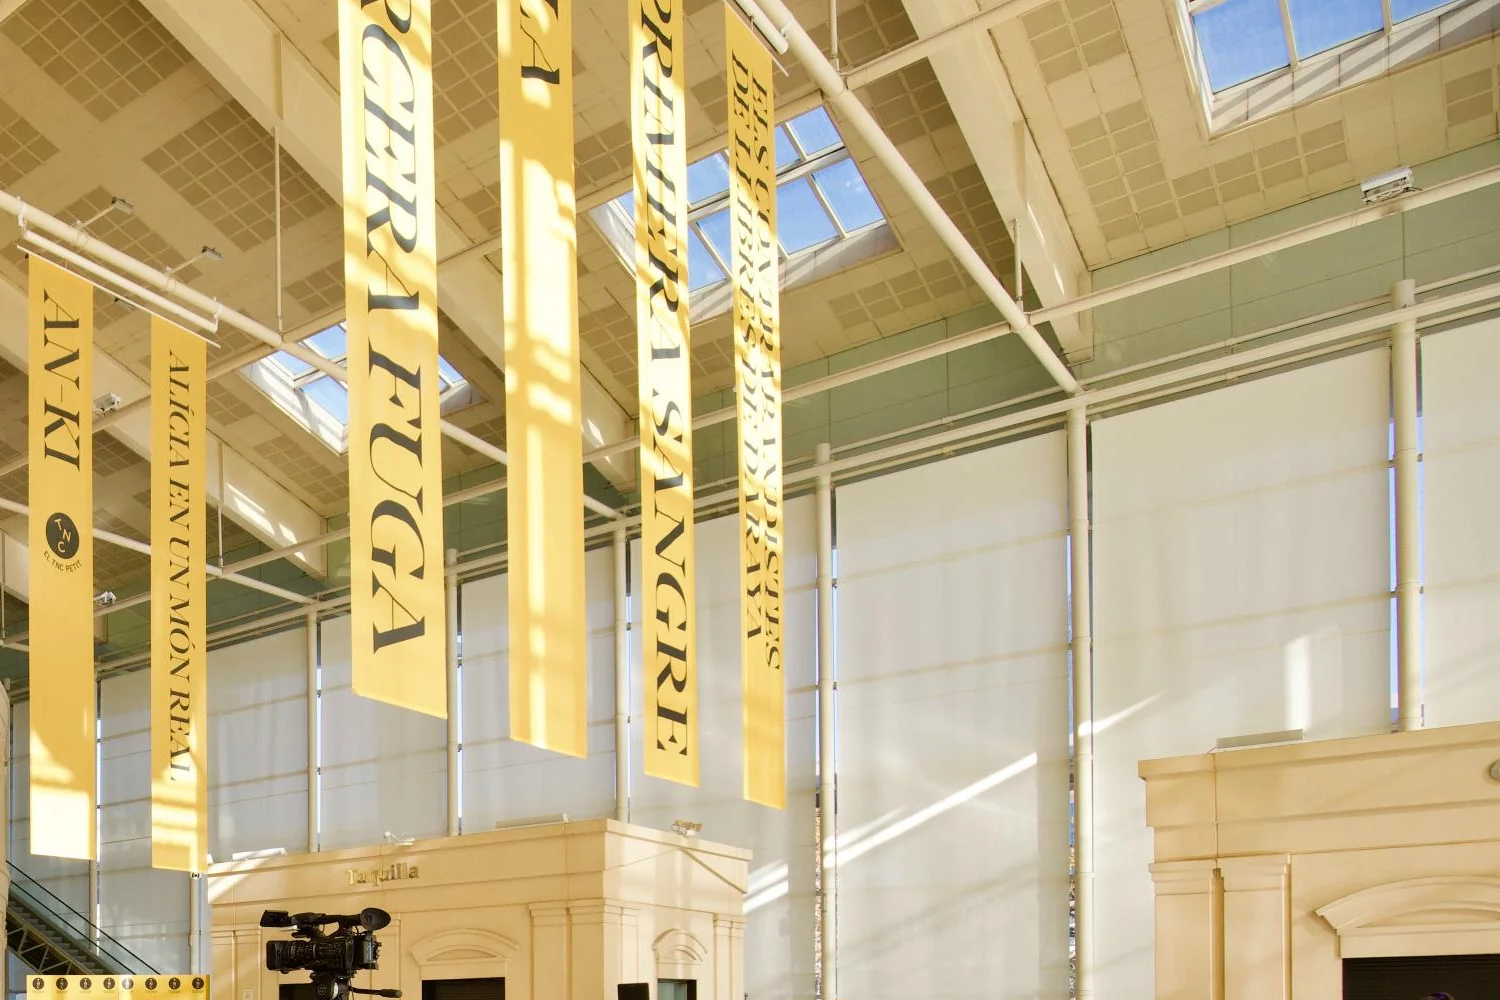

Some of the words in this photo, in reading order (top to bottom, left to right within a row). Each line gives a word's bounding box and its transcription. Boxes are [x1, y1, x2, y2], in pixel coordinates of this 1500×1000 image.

[731, 50, 749, 128] DE
[752, 74, 770, 170] ELS
[735, 131, 757, 347] LLIBRES
[43, 289, 81, 472] AN-KI
[169, 349, 195, 468] ALÍCIA
[741, 359, 761, 430] DE
[170, 476, 190, 531] EN
[368, 336, 426, 655] FUGA
[744, 440, 762, 640] DARAYA
[169, 536, 190, 590] UN
[652, 388, 687, 756] SANGRE
[170, 592, 196, 682] MÓN
[170, 687, 191, 781] REAL
[346, 863, 419, 887] Taquilla
